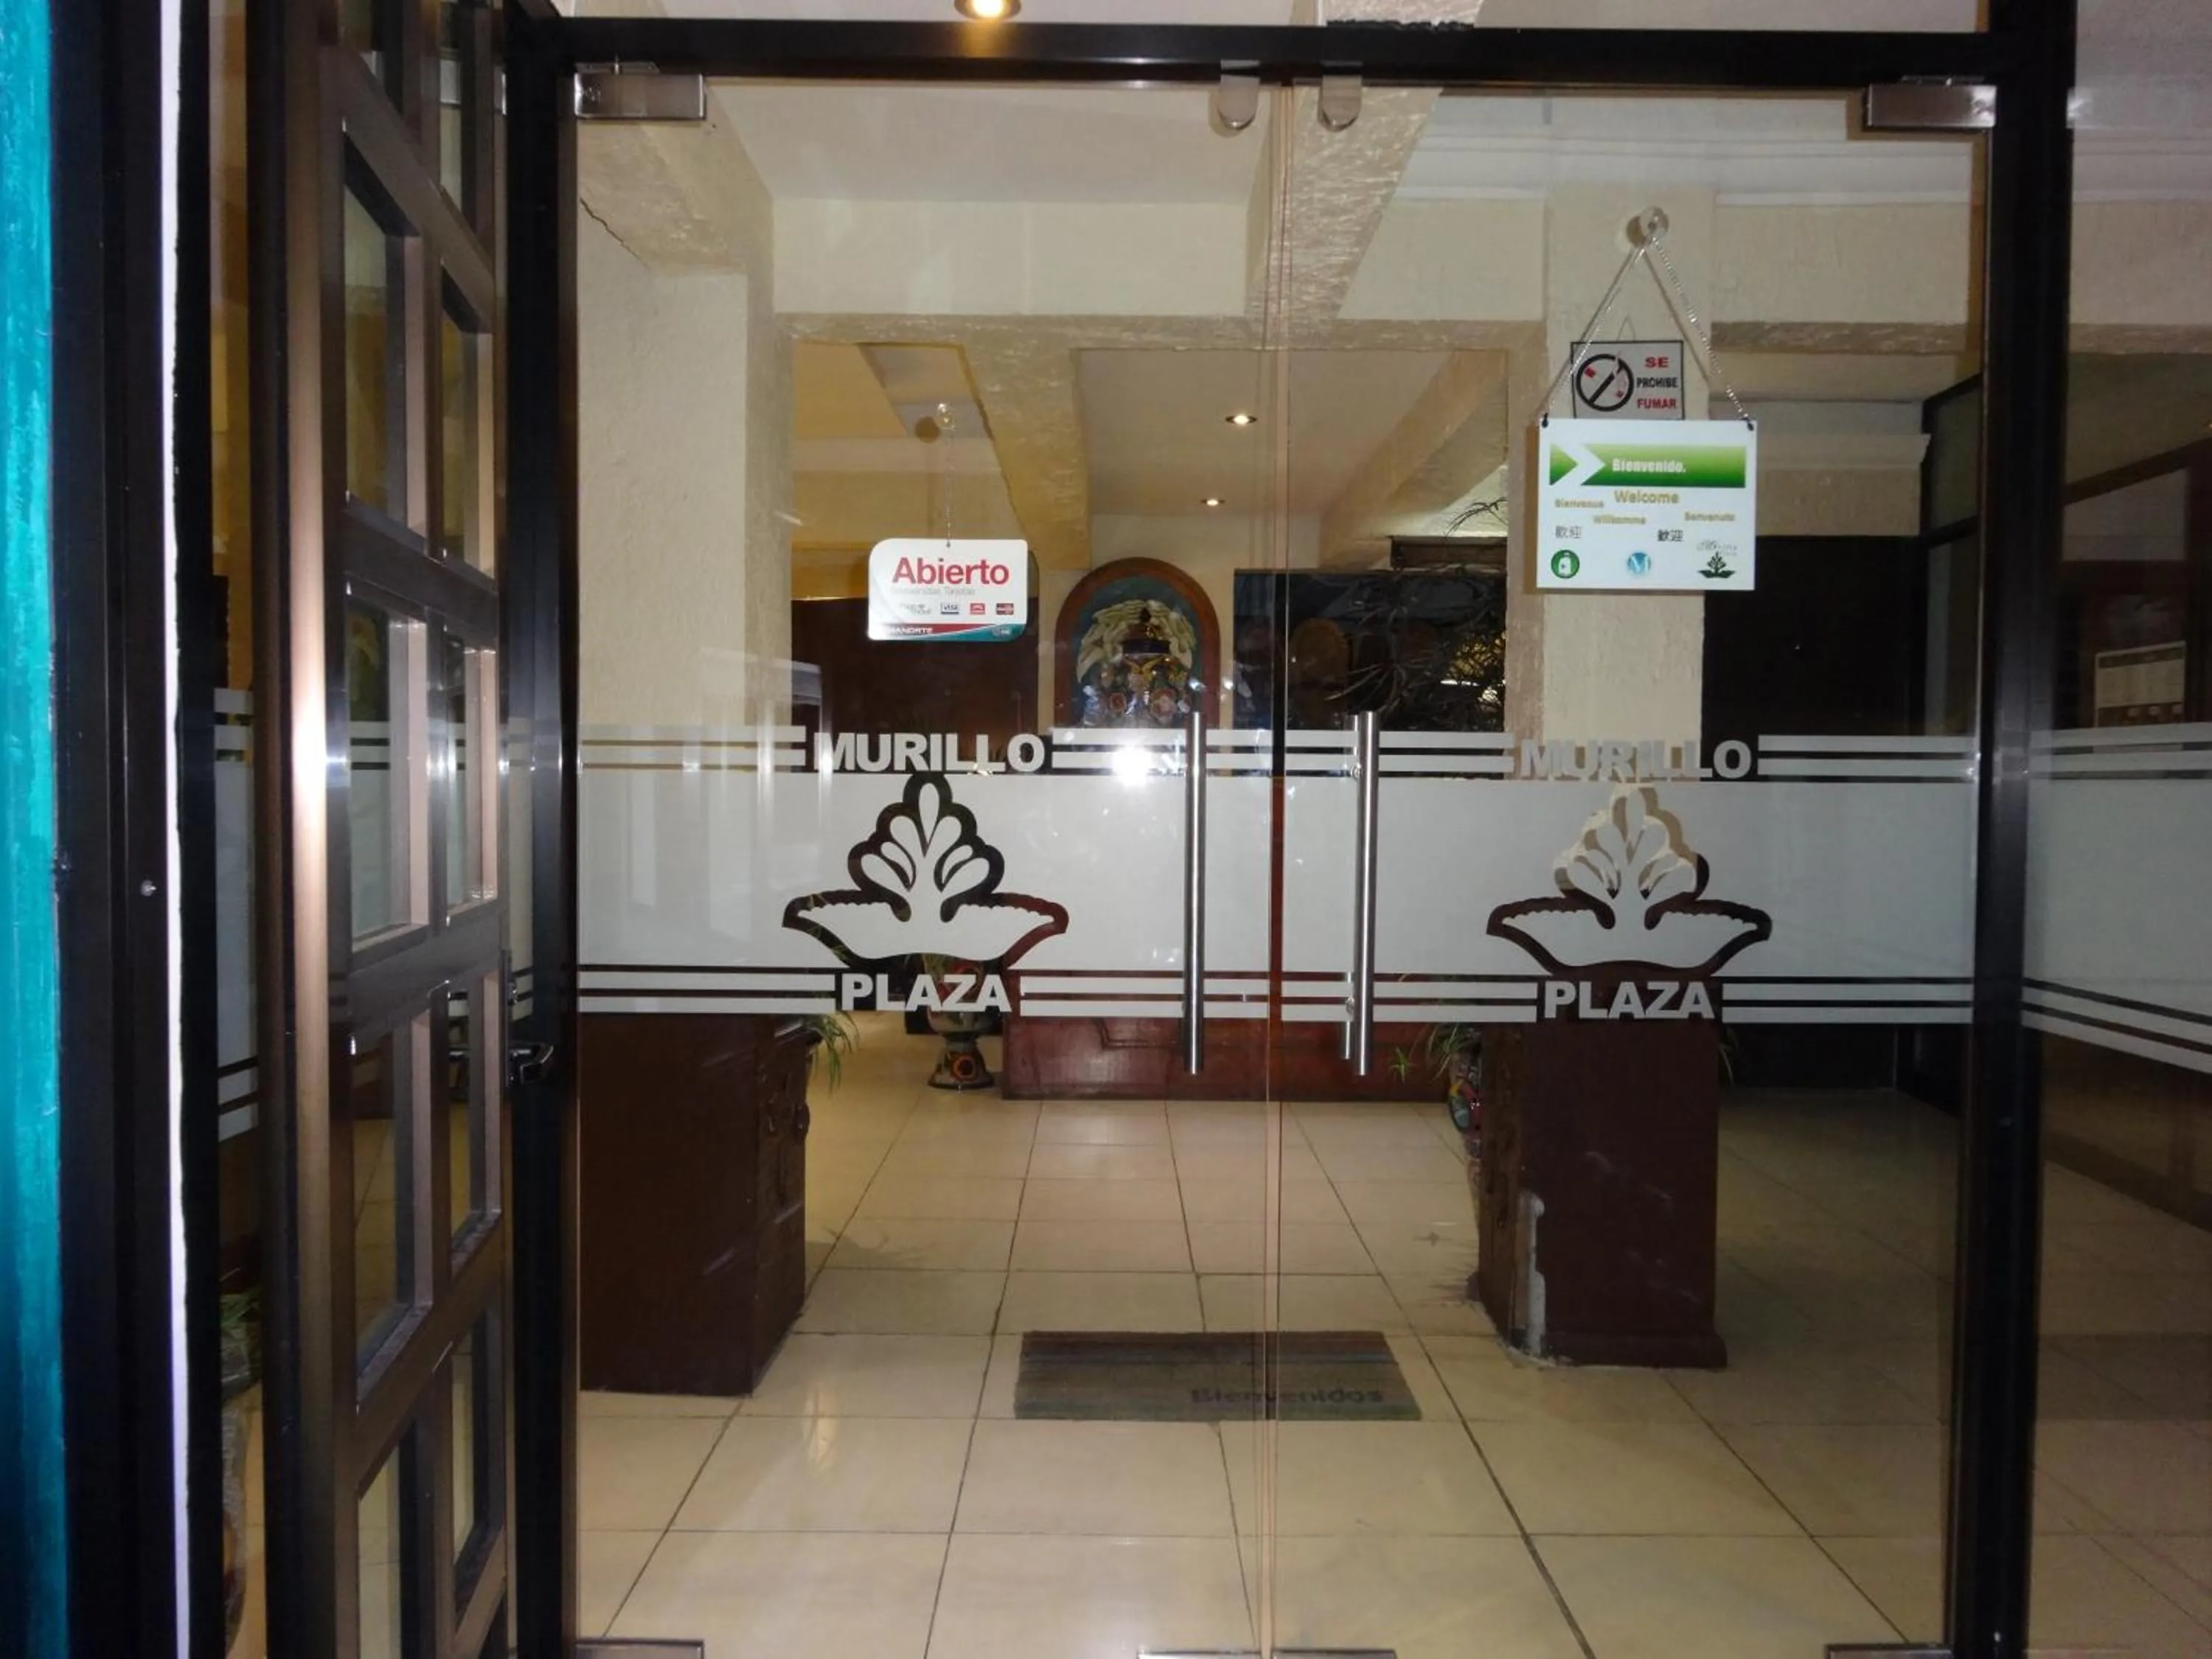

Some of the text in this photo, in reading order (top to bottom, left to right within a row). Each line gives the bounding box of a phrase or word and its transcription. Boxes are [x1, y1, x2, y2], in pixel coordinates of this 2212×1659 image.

[1645, 356, 1669, 368] SE
[1636, 377, 1677, 388] PROHIBE
[1637, 398, 1677, 409] FUMAR
[1613, 490, 1680, 504] Welcome
[892, 557, 1009, 585] Abierto
[813, 732, 1046, 772] MURILLO
[1521, 739, 1752, 779] MURILLO
[841, 973, 1012, 1012] PLAZA
[1544, 981, 1715, 1020] PLAZA
